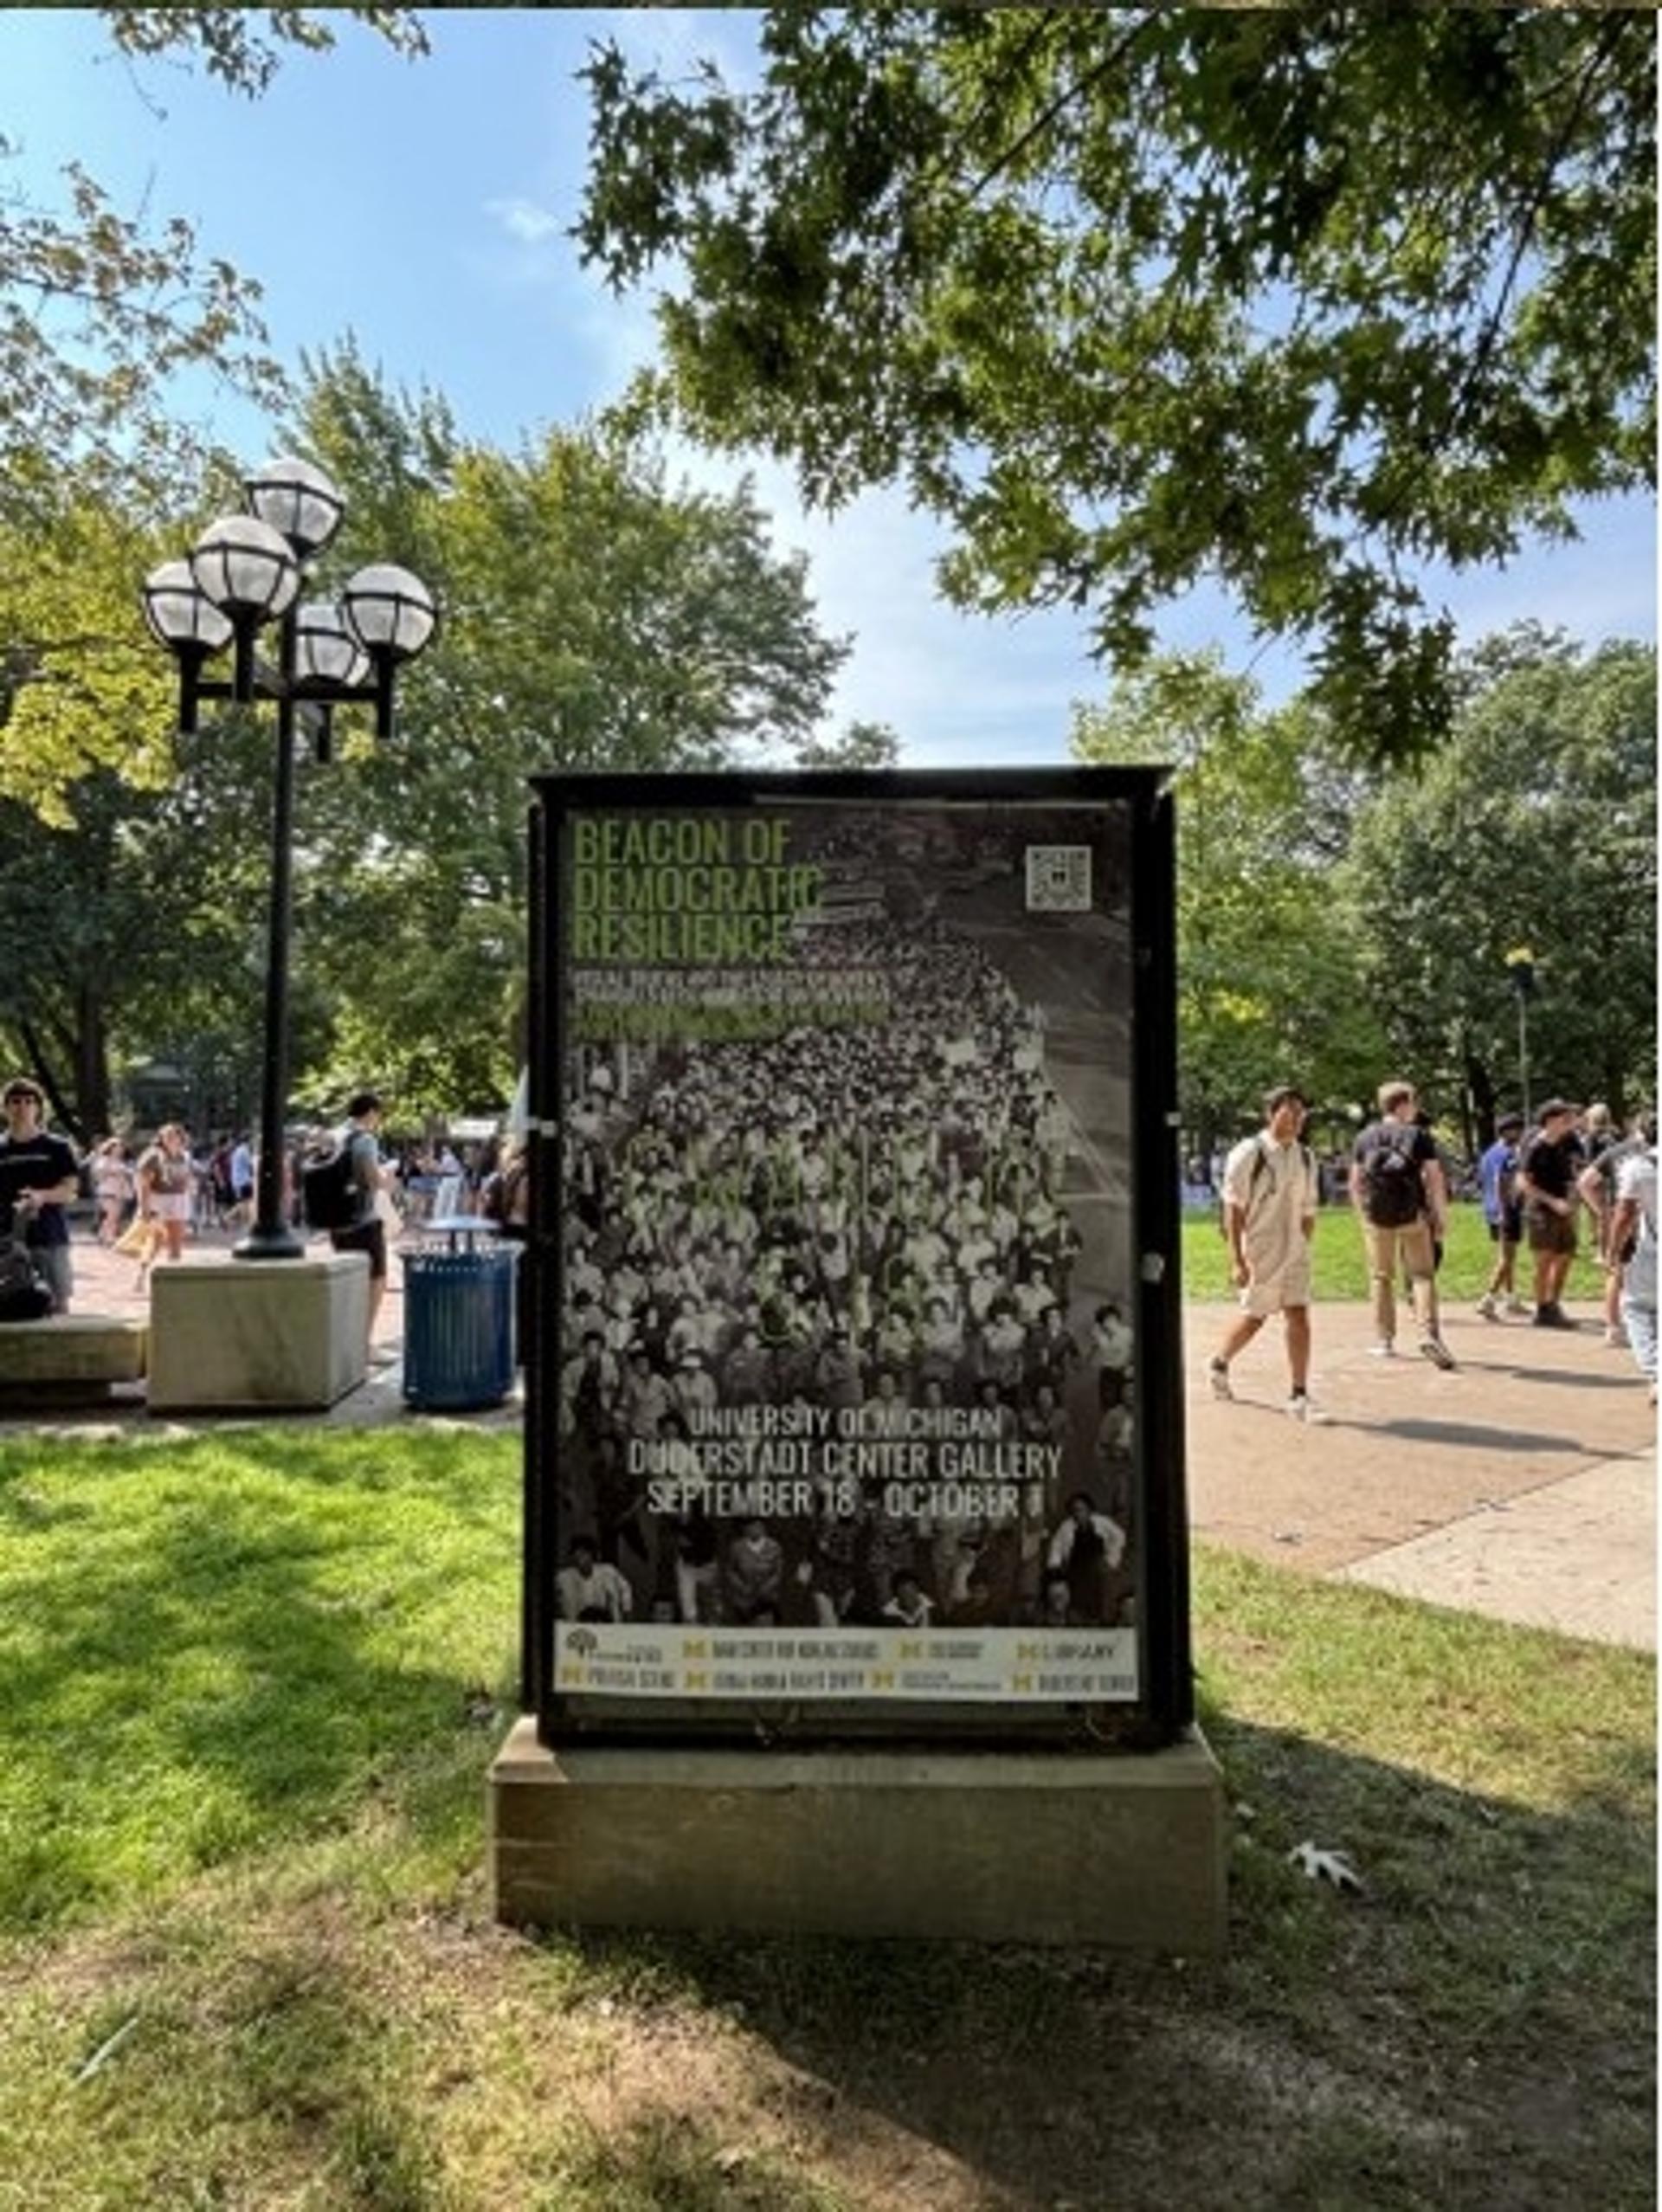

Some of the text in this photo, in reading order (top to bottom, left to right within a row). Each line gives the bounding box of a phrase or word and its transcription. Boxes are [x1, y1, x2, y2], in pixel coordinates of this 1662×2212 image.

[575, 819, 791, 864] BEACON OF
[575, 866, 821, 911] DEMOCRATIC
[575, 913, 794, 960] RESILIENCE
[629, 1438, 1063, 1479] DUDERSTADT CENTER GALLERY
[647, 1480, 813, 1517] SEPTEMBER
[823, 1480, 857, 1517] 18
[883, 1481, 1020, 1518] OCTOBER
